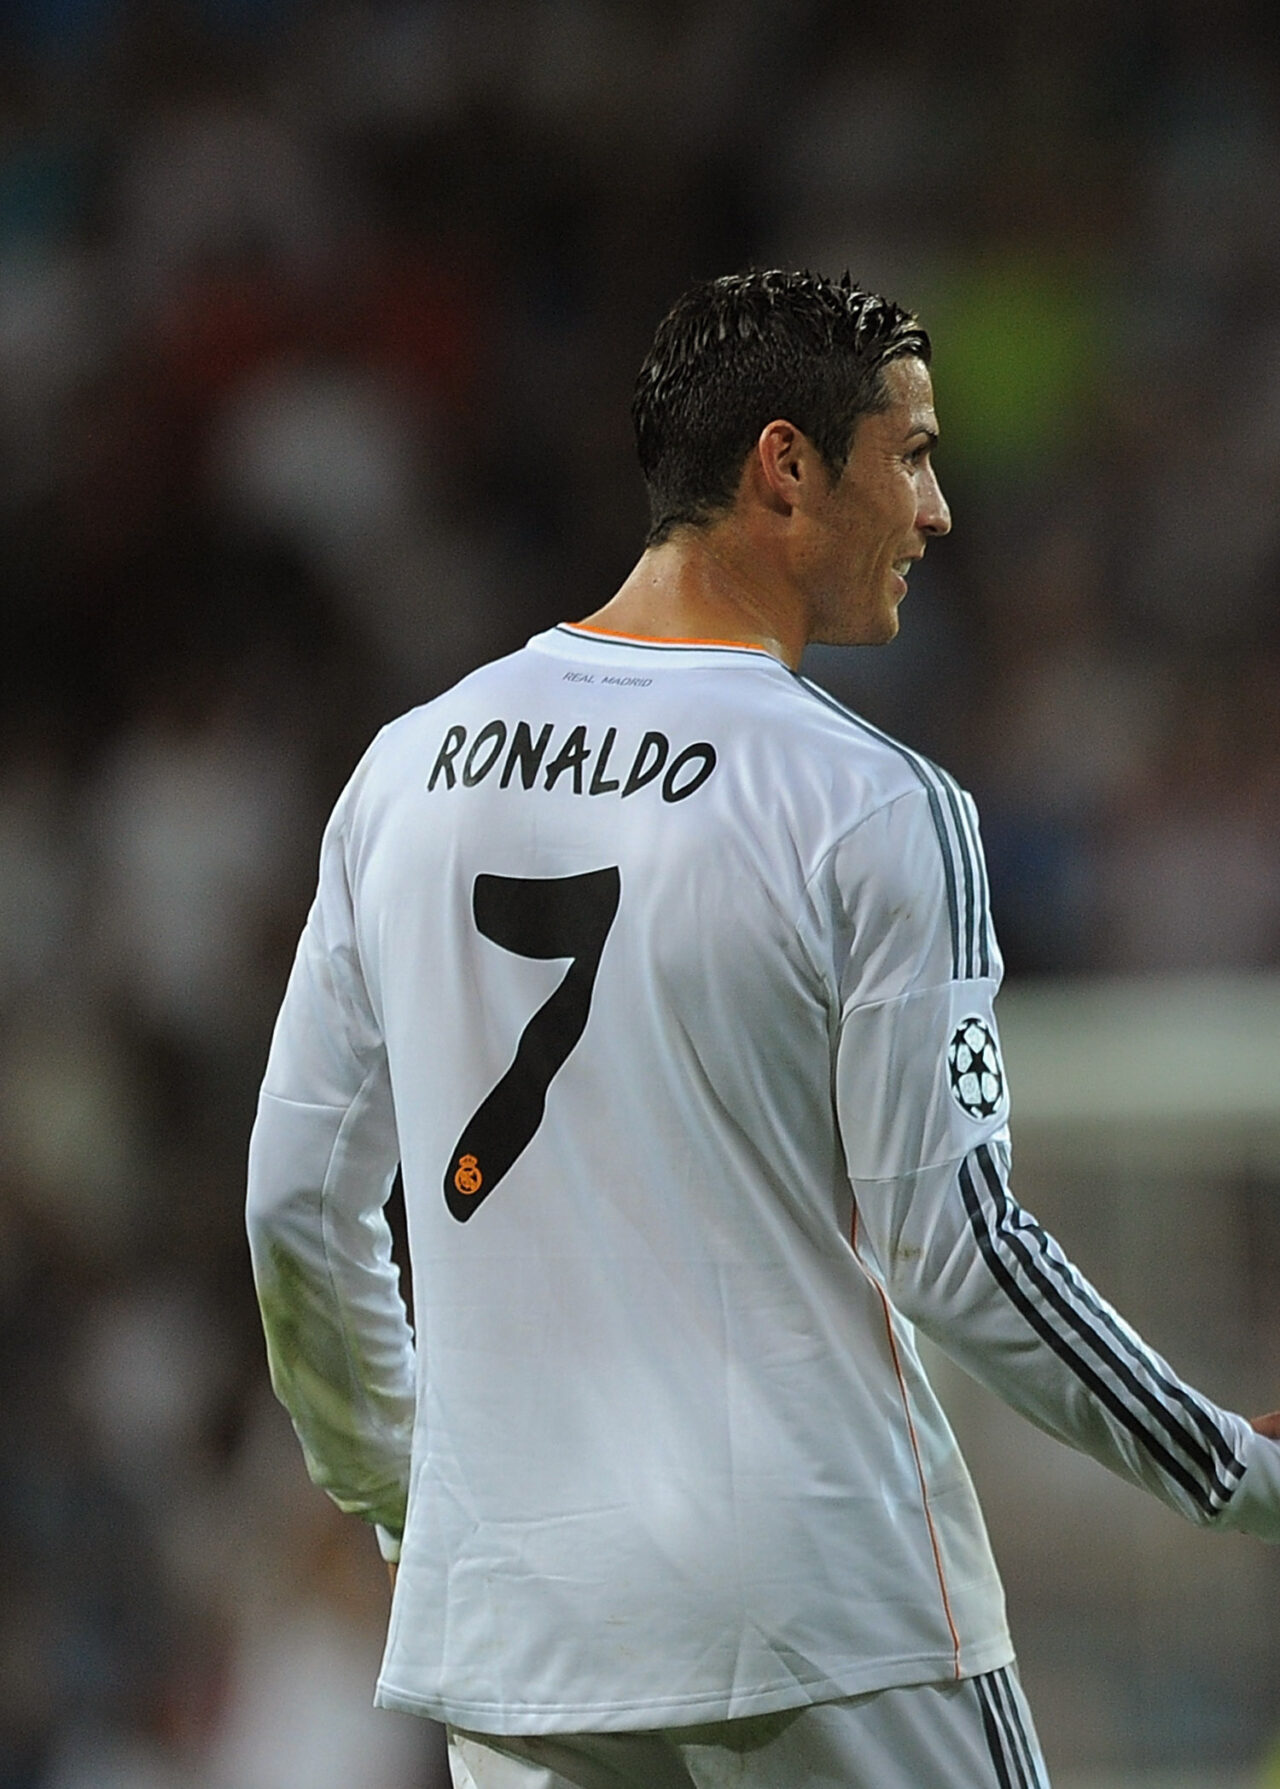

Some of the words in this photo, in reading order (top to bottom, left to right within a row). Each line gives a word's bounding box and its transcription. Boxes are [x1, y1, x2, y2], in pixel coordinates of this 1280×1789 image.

[562, 671, 595, 684] REAL
[601, 676, 653, 688] MADRID
[427, 719, 717, 803] RONALDO
[443, 865, 622, 1223] 7
